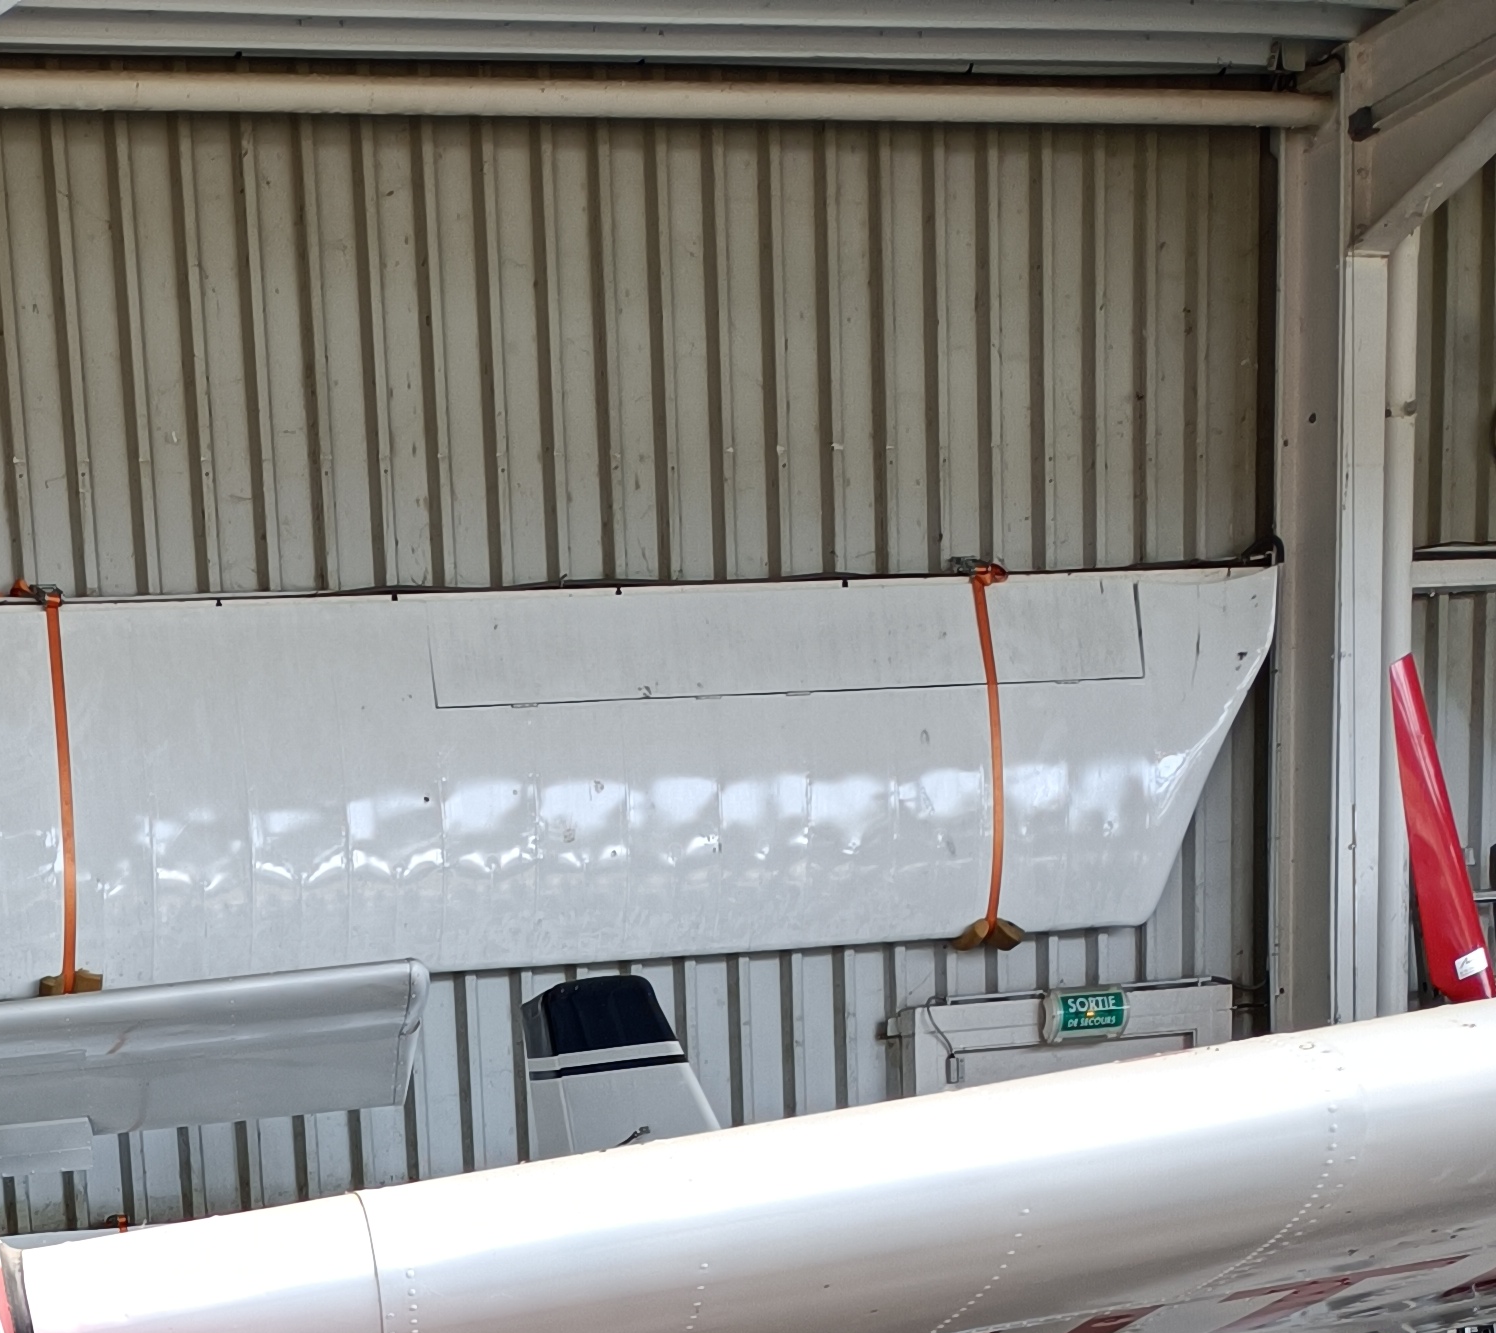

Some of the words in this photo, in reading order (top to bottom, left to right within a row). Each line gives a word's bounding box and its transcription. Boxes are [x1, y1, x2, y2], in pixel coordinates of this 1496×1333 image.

[1067, 996, 1116, 1013] SORTIE
[1067, 1018, 1079, 1028] DE
[1080, 1016, 1116, 1027] SECOURS
